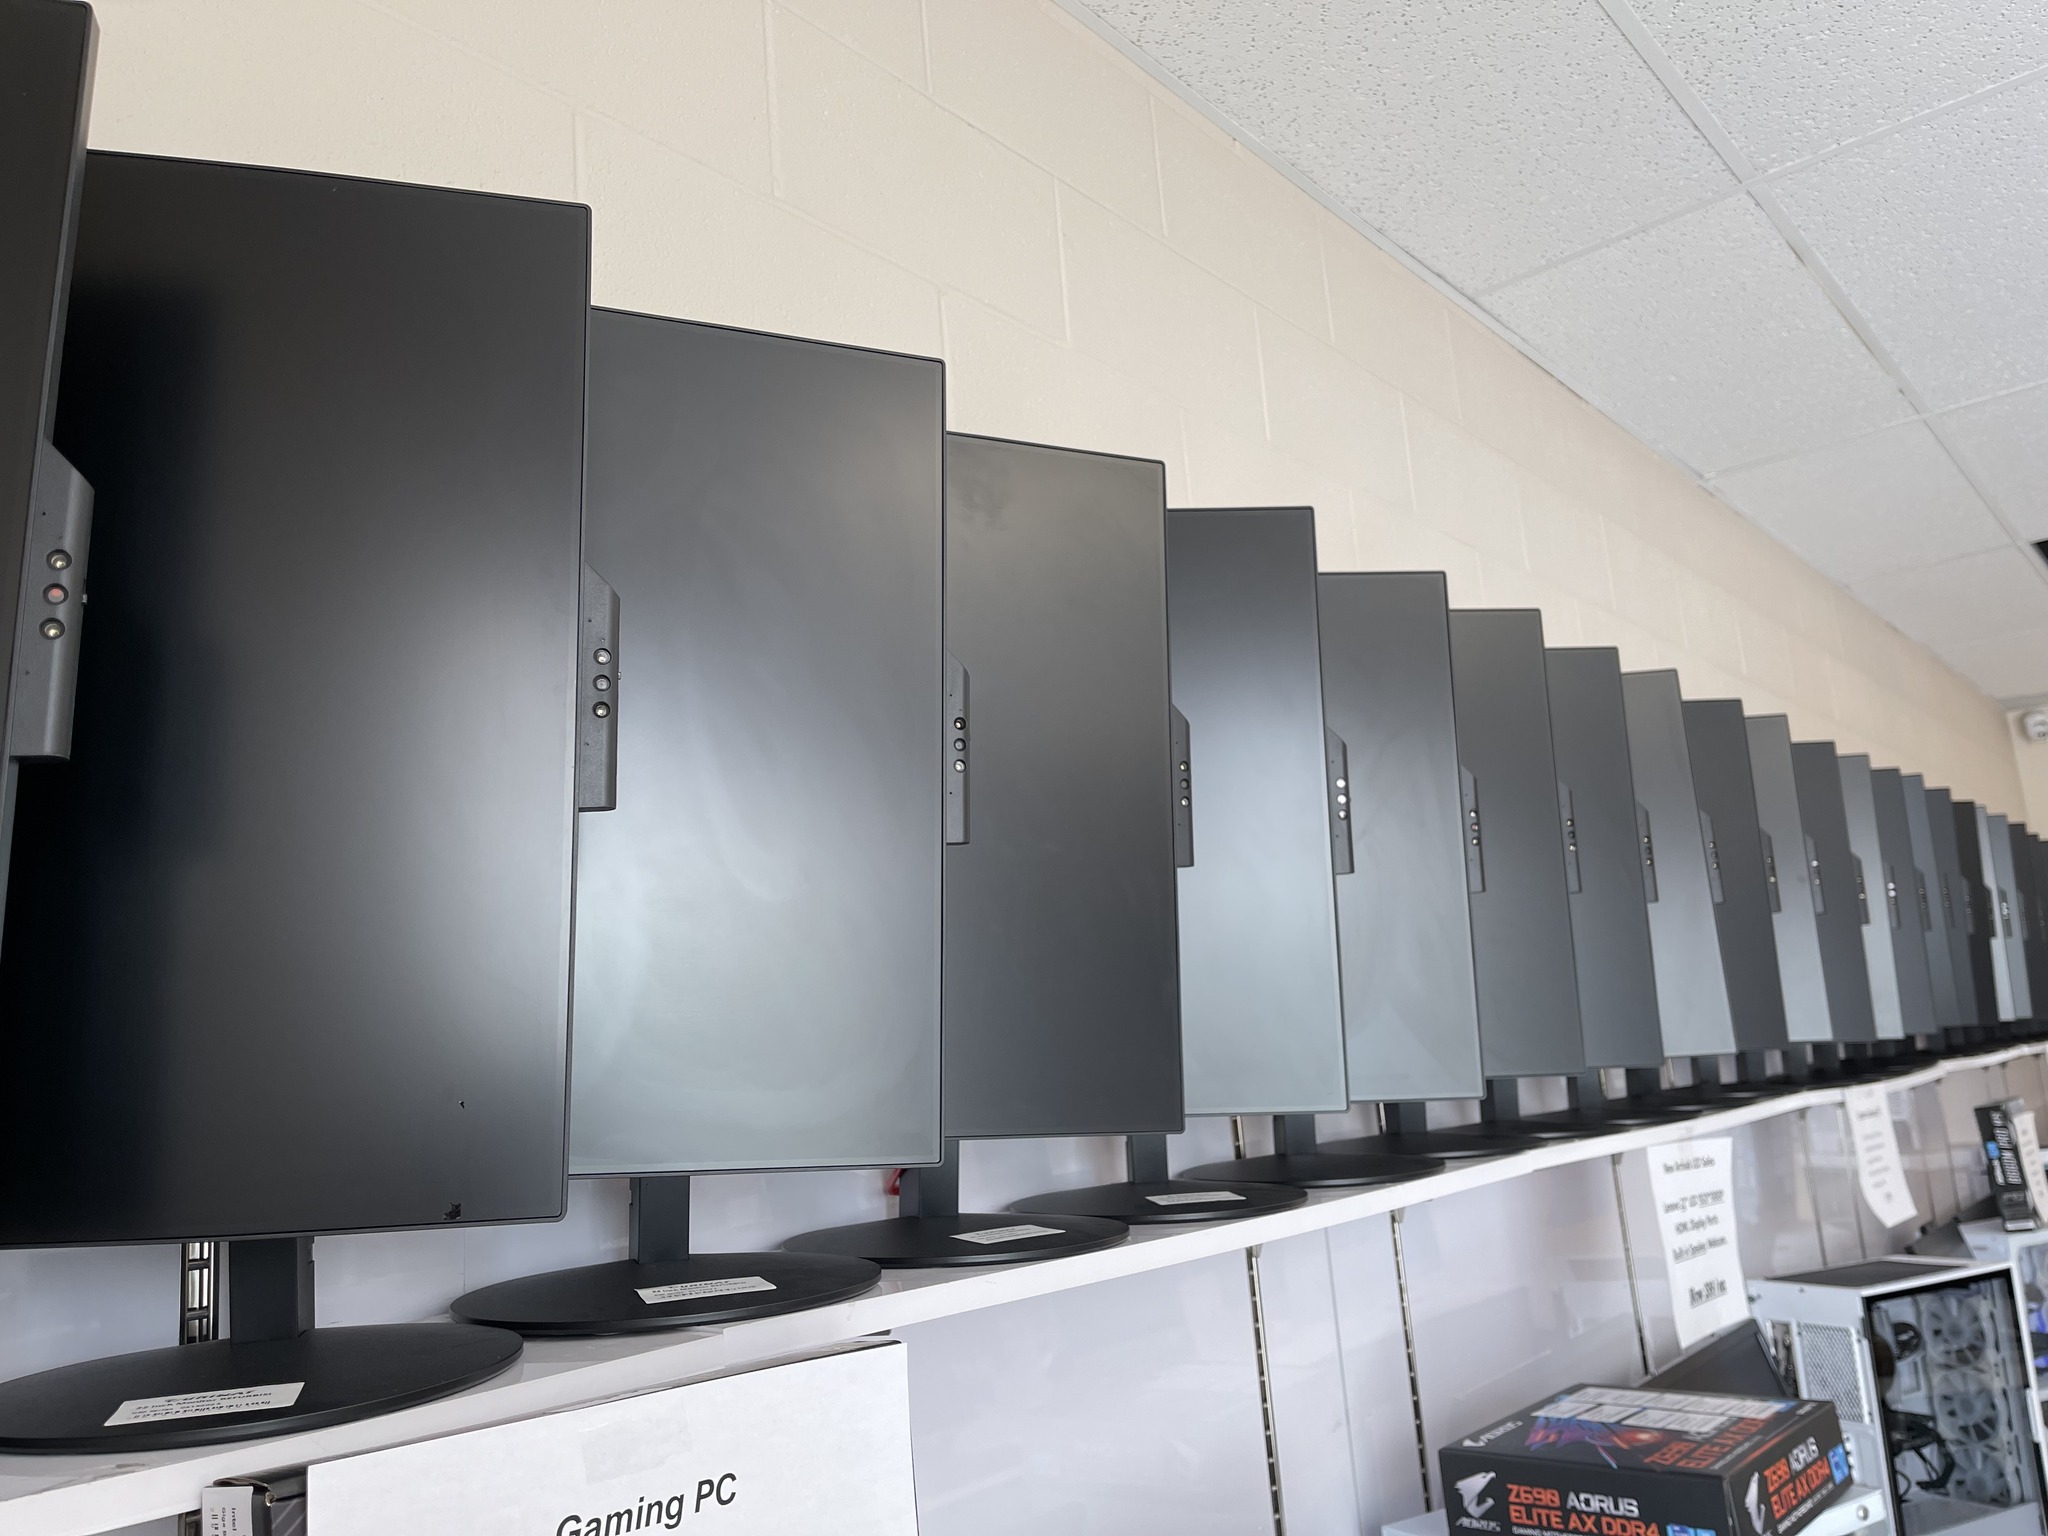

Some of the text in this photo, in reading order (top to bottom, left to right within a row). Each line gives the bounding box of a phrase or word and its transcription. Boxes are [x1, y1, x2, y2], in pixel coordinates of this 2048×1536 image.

[556, 1473, 737, 1536] Gaming PC
[1506, 1484, 1639, 1518] Z690 AORUS
[1509, 1506, 1660, 1536] ELITE AX DDR4
